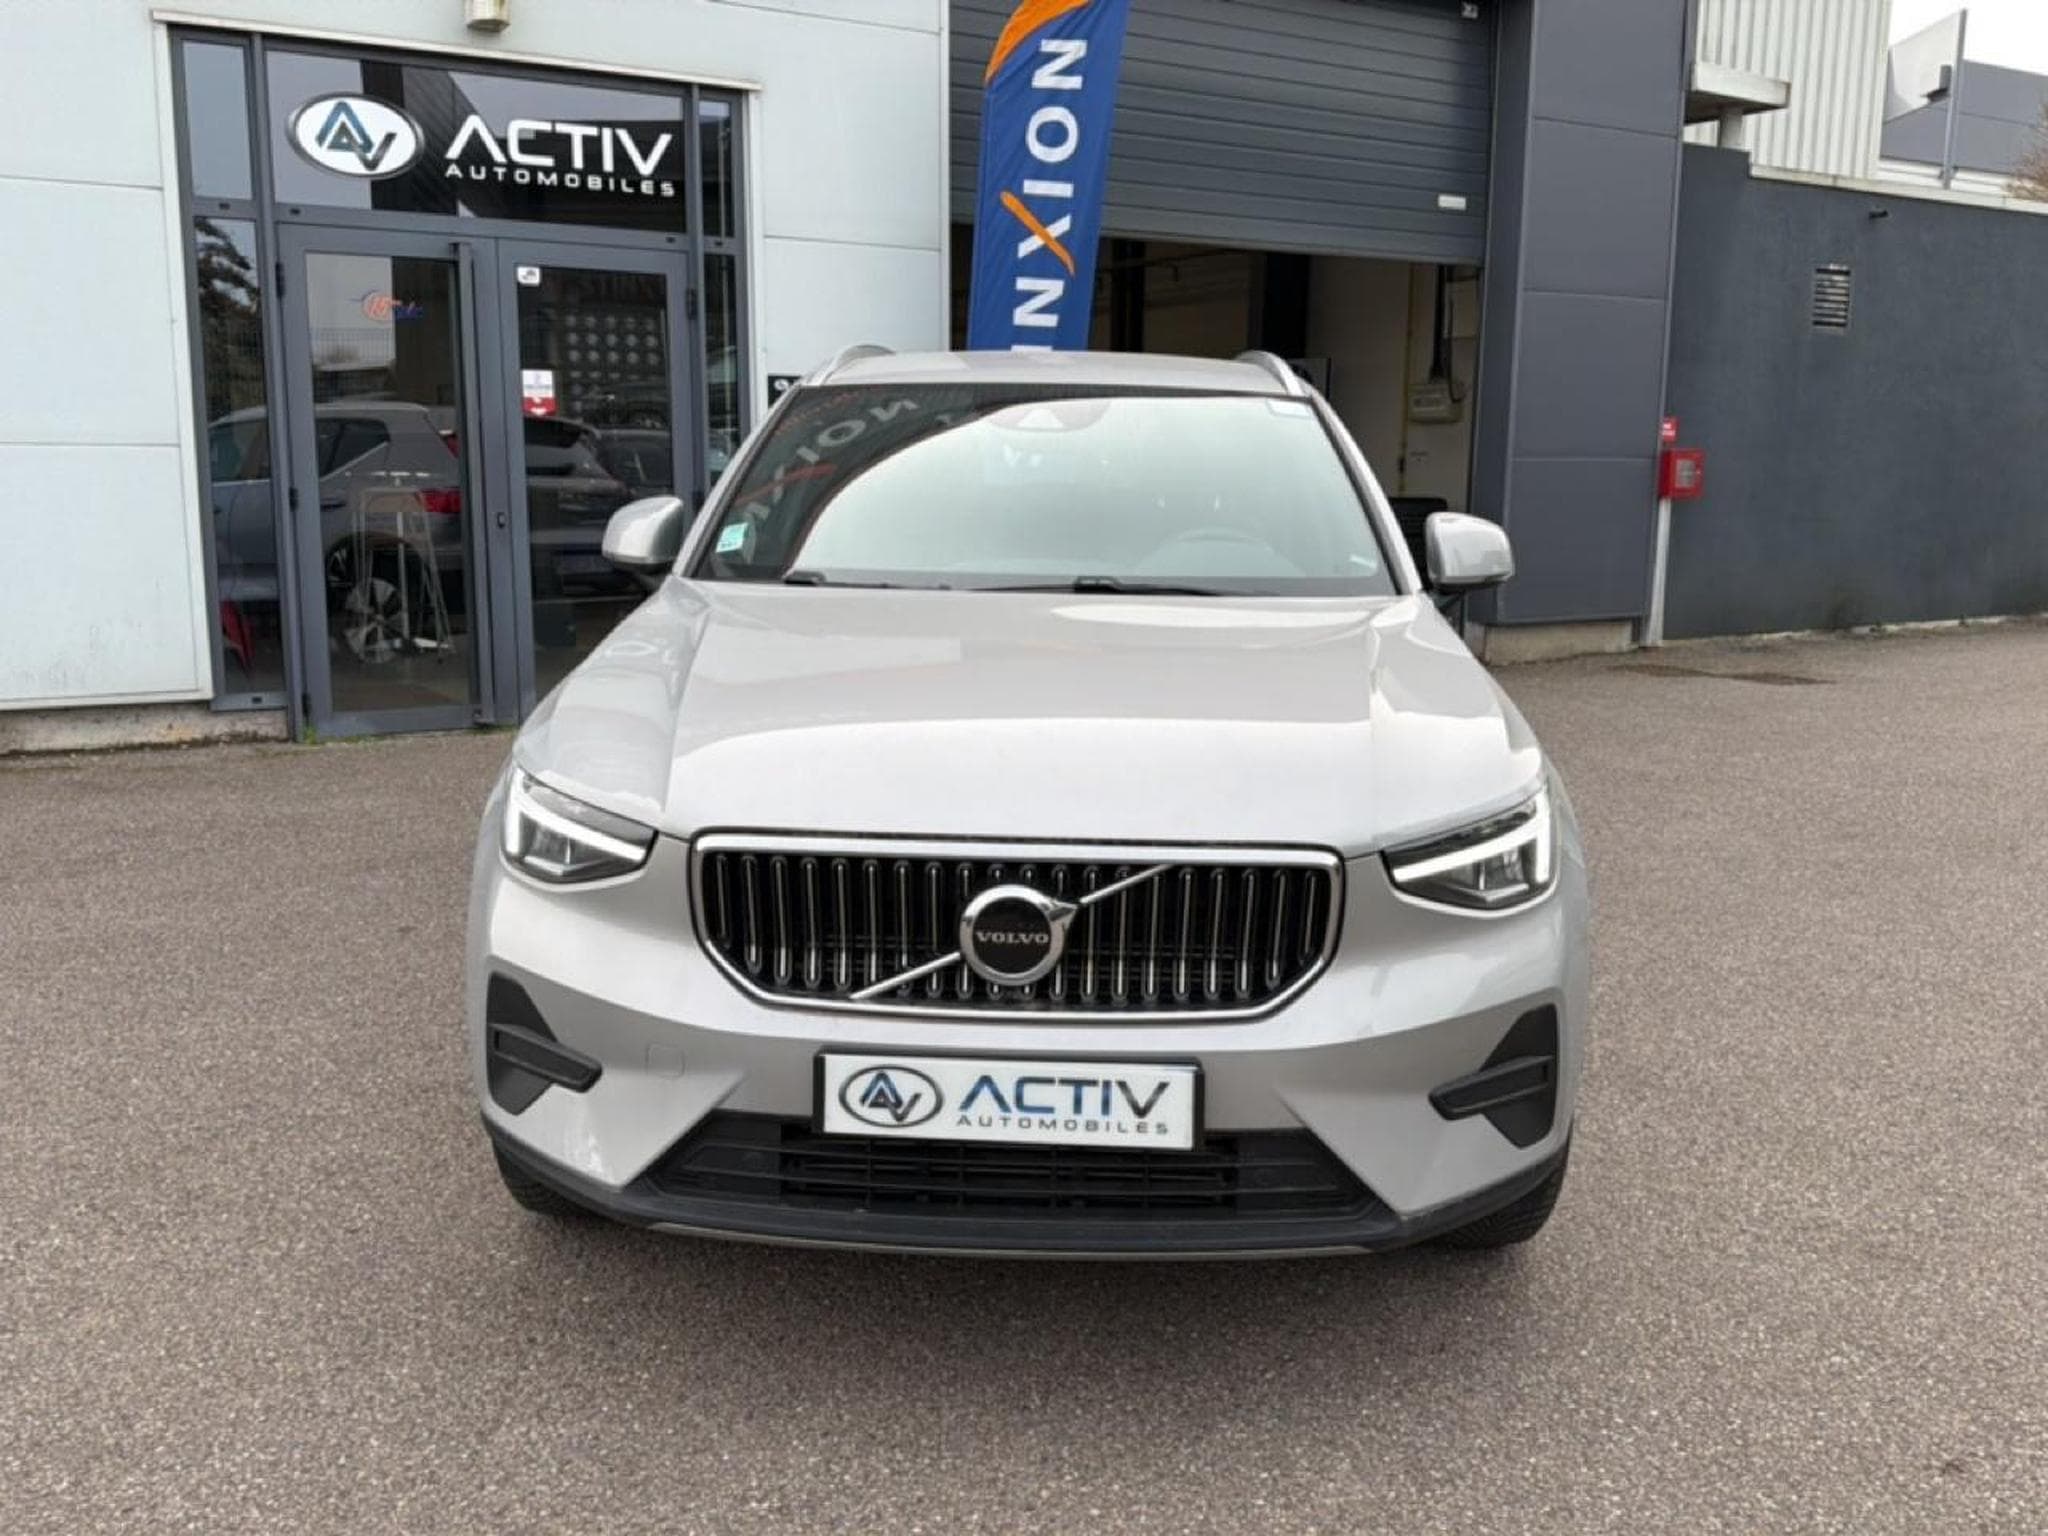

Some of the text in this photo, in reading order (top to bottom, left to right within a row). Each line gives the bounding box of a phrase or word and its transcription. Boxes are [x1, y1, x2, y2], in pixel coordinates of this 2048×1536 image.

[445, 114, 673, 176] ACTIV
[445, 163, 675, 197] AUTOMOBILES
[975, 931, 1050, 944] VOLVO
[959, 1074, 1171, 1119] ACTIV
[956, 1114, 1169, 1135] AUTOMOBILES
